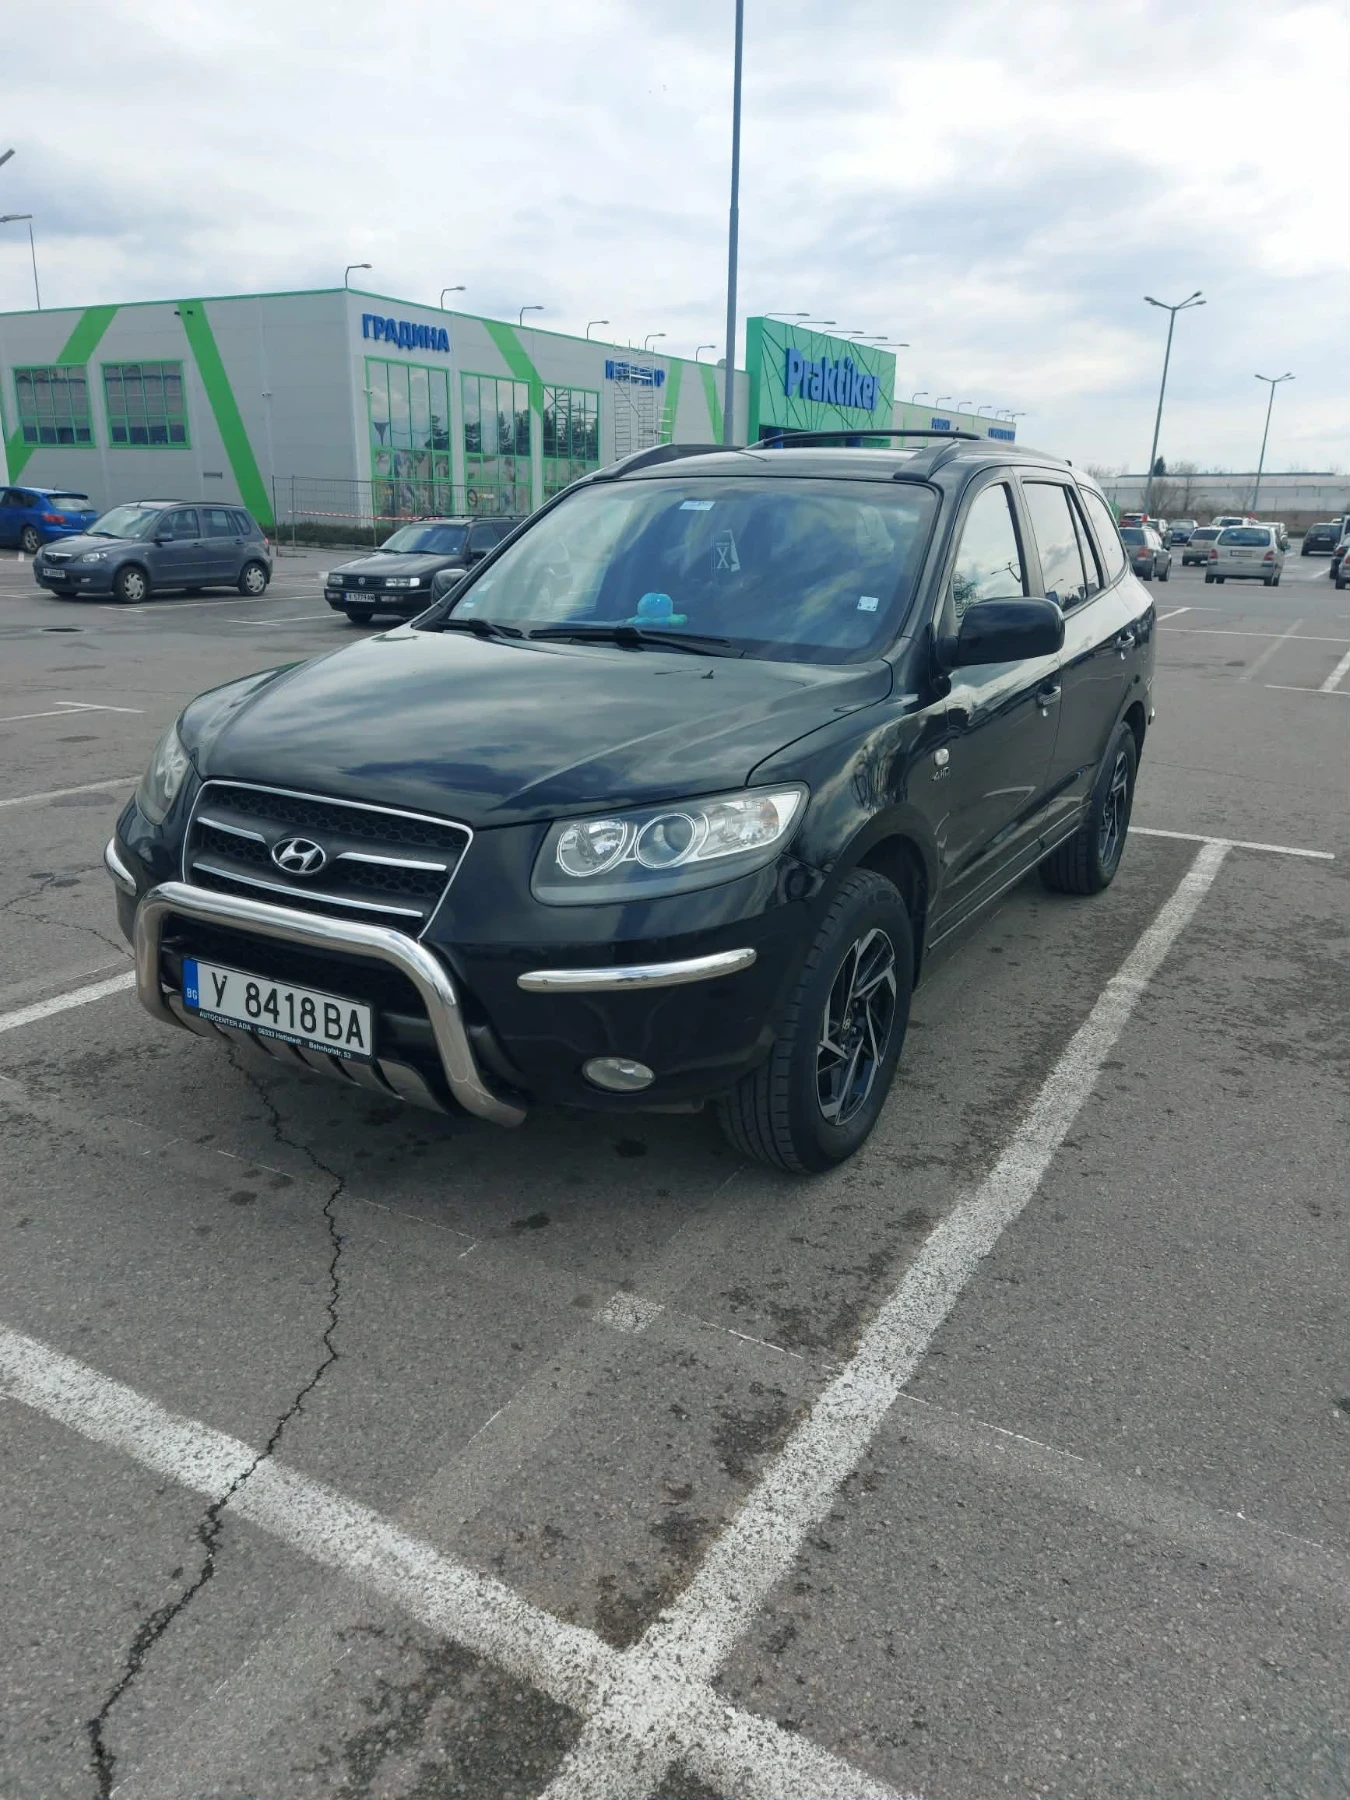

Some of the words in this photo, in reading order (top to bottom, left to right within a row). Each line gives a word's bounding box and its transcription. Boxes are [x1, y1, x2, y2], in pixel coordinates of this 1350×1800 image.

[362, 313, 450, 352] ГРАДИНА
[784, 347, 880, 411] Praktiker
[186, 987, 198, 1000] BG
[199, 1011, 237, 1026] AUTOCENTER
